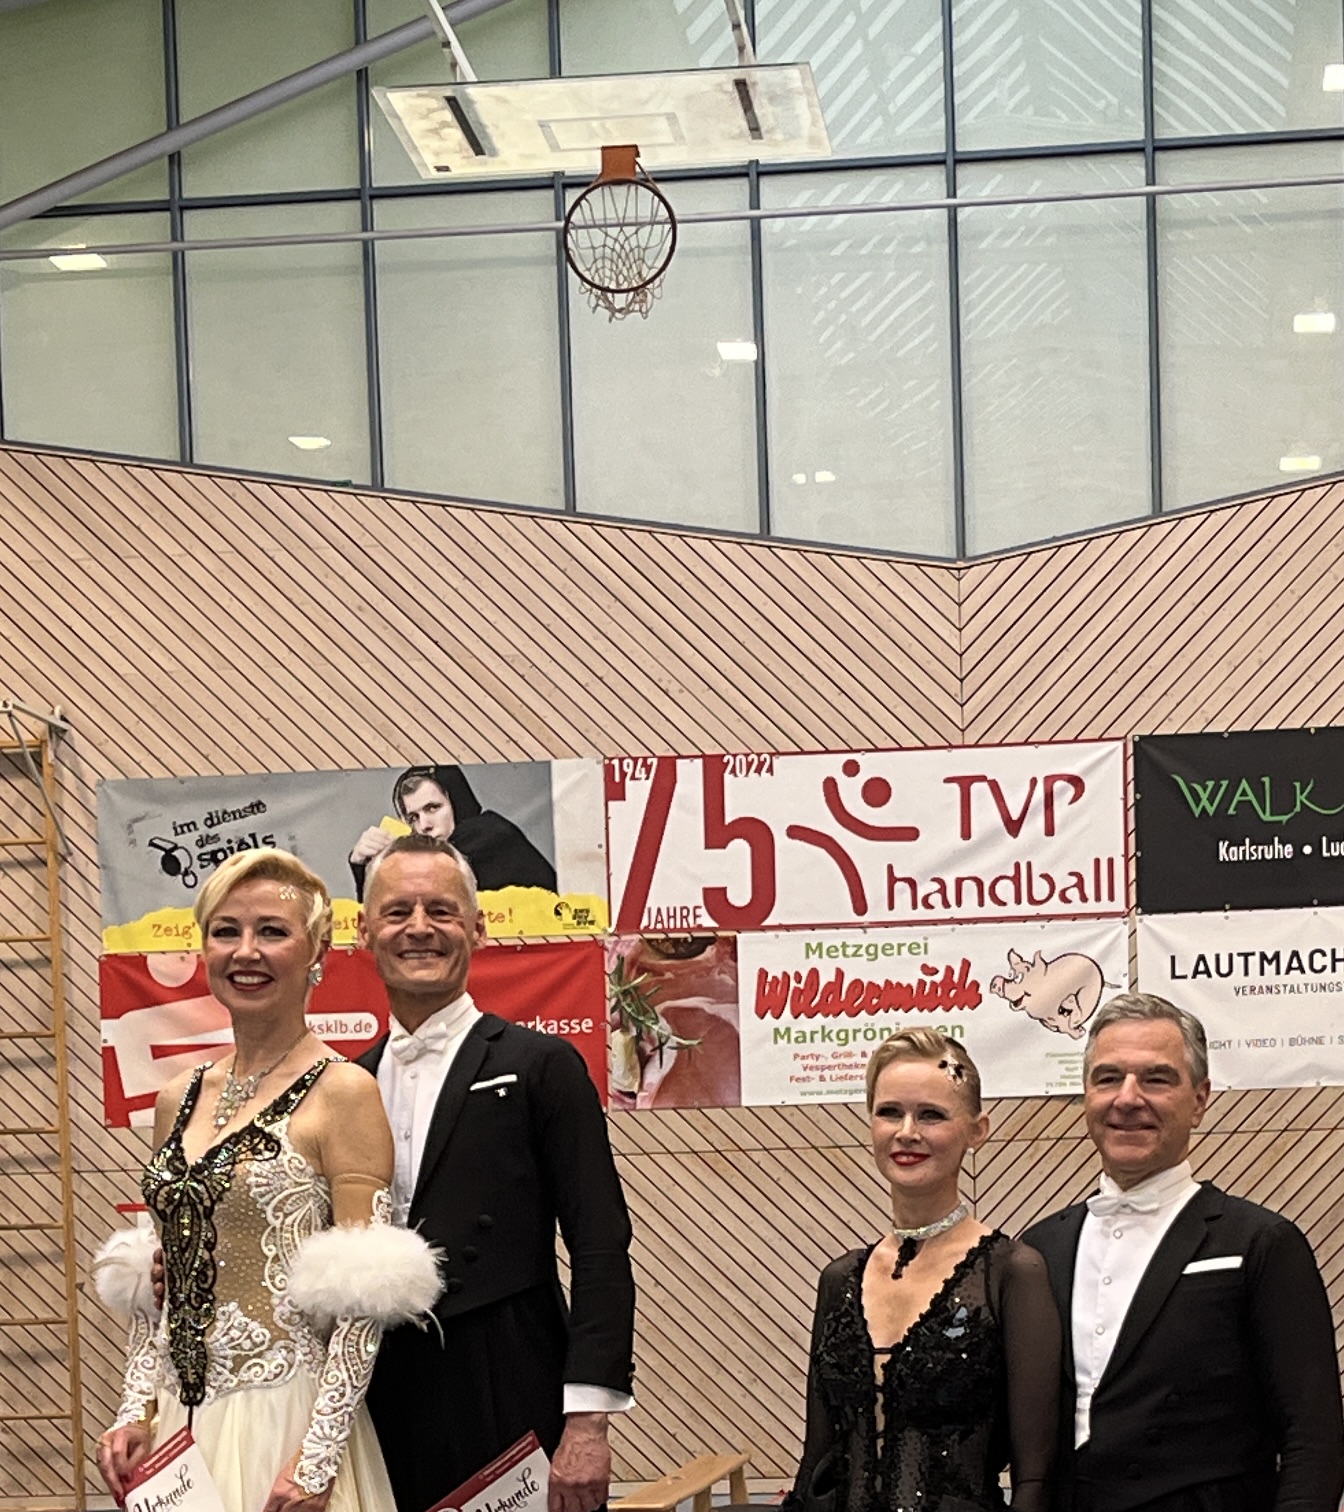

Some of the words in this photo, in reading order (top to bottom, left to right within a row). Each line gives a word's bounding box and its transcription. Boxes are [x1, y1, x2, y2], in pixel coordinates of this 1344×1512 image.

[606, 757, 658, 784] 1947
[722, 753, 774, 777] 2022
[172, 820, 199, 836] im
[203, 799, 268, 829] dienste
[942, 773, 1086, 840] TVP
[195, 832, 221, 849] des
[197, 832, 277, 870] spiels
[1218, 837, 1294, 862] Karlsruhe
[887, 857, 1115, 911] handball
[644, 904, 703, 929] JAHRE
[804, 937, 929, 963] Metzgerei
[755, 957, 983, 1020] Wildermüth
[772, 1021, 965, 1047] Markgrönen
[1208, 1039, 1233, 1050] ICHT
[1245, 1037, 1277, 1049] VIDEO
[1288, 1033, 1326, 1047] BÜHNE
